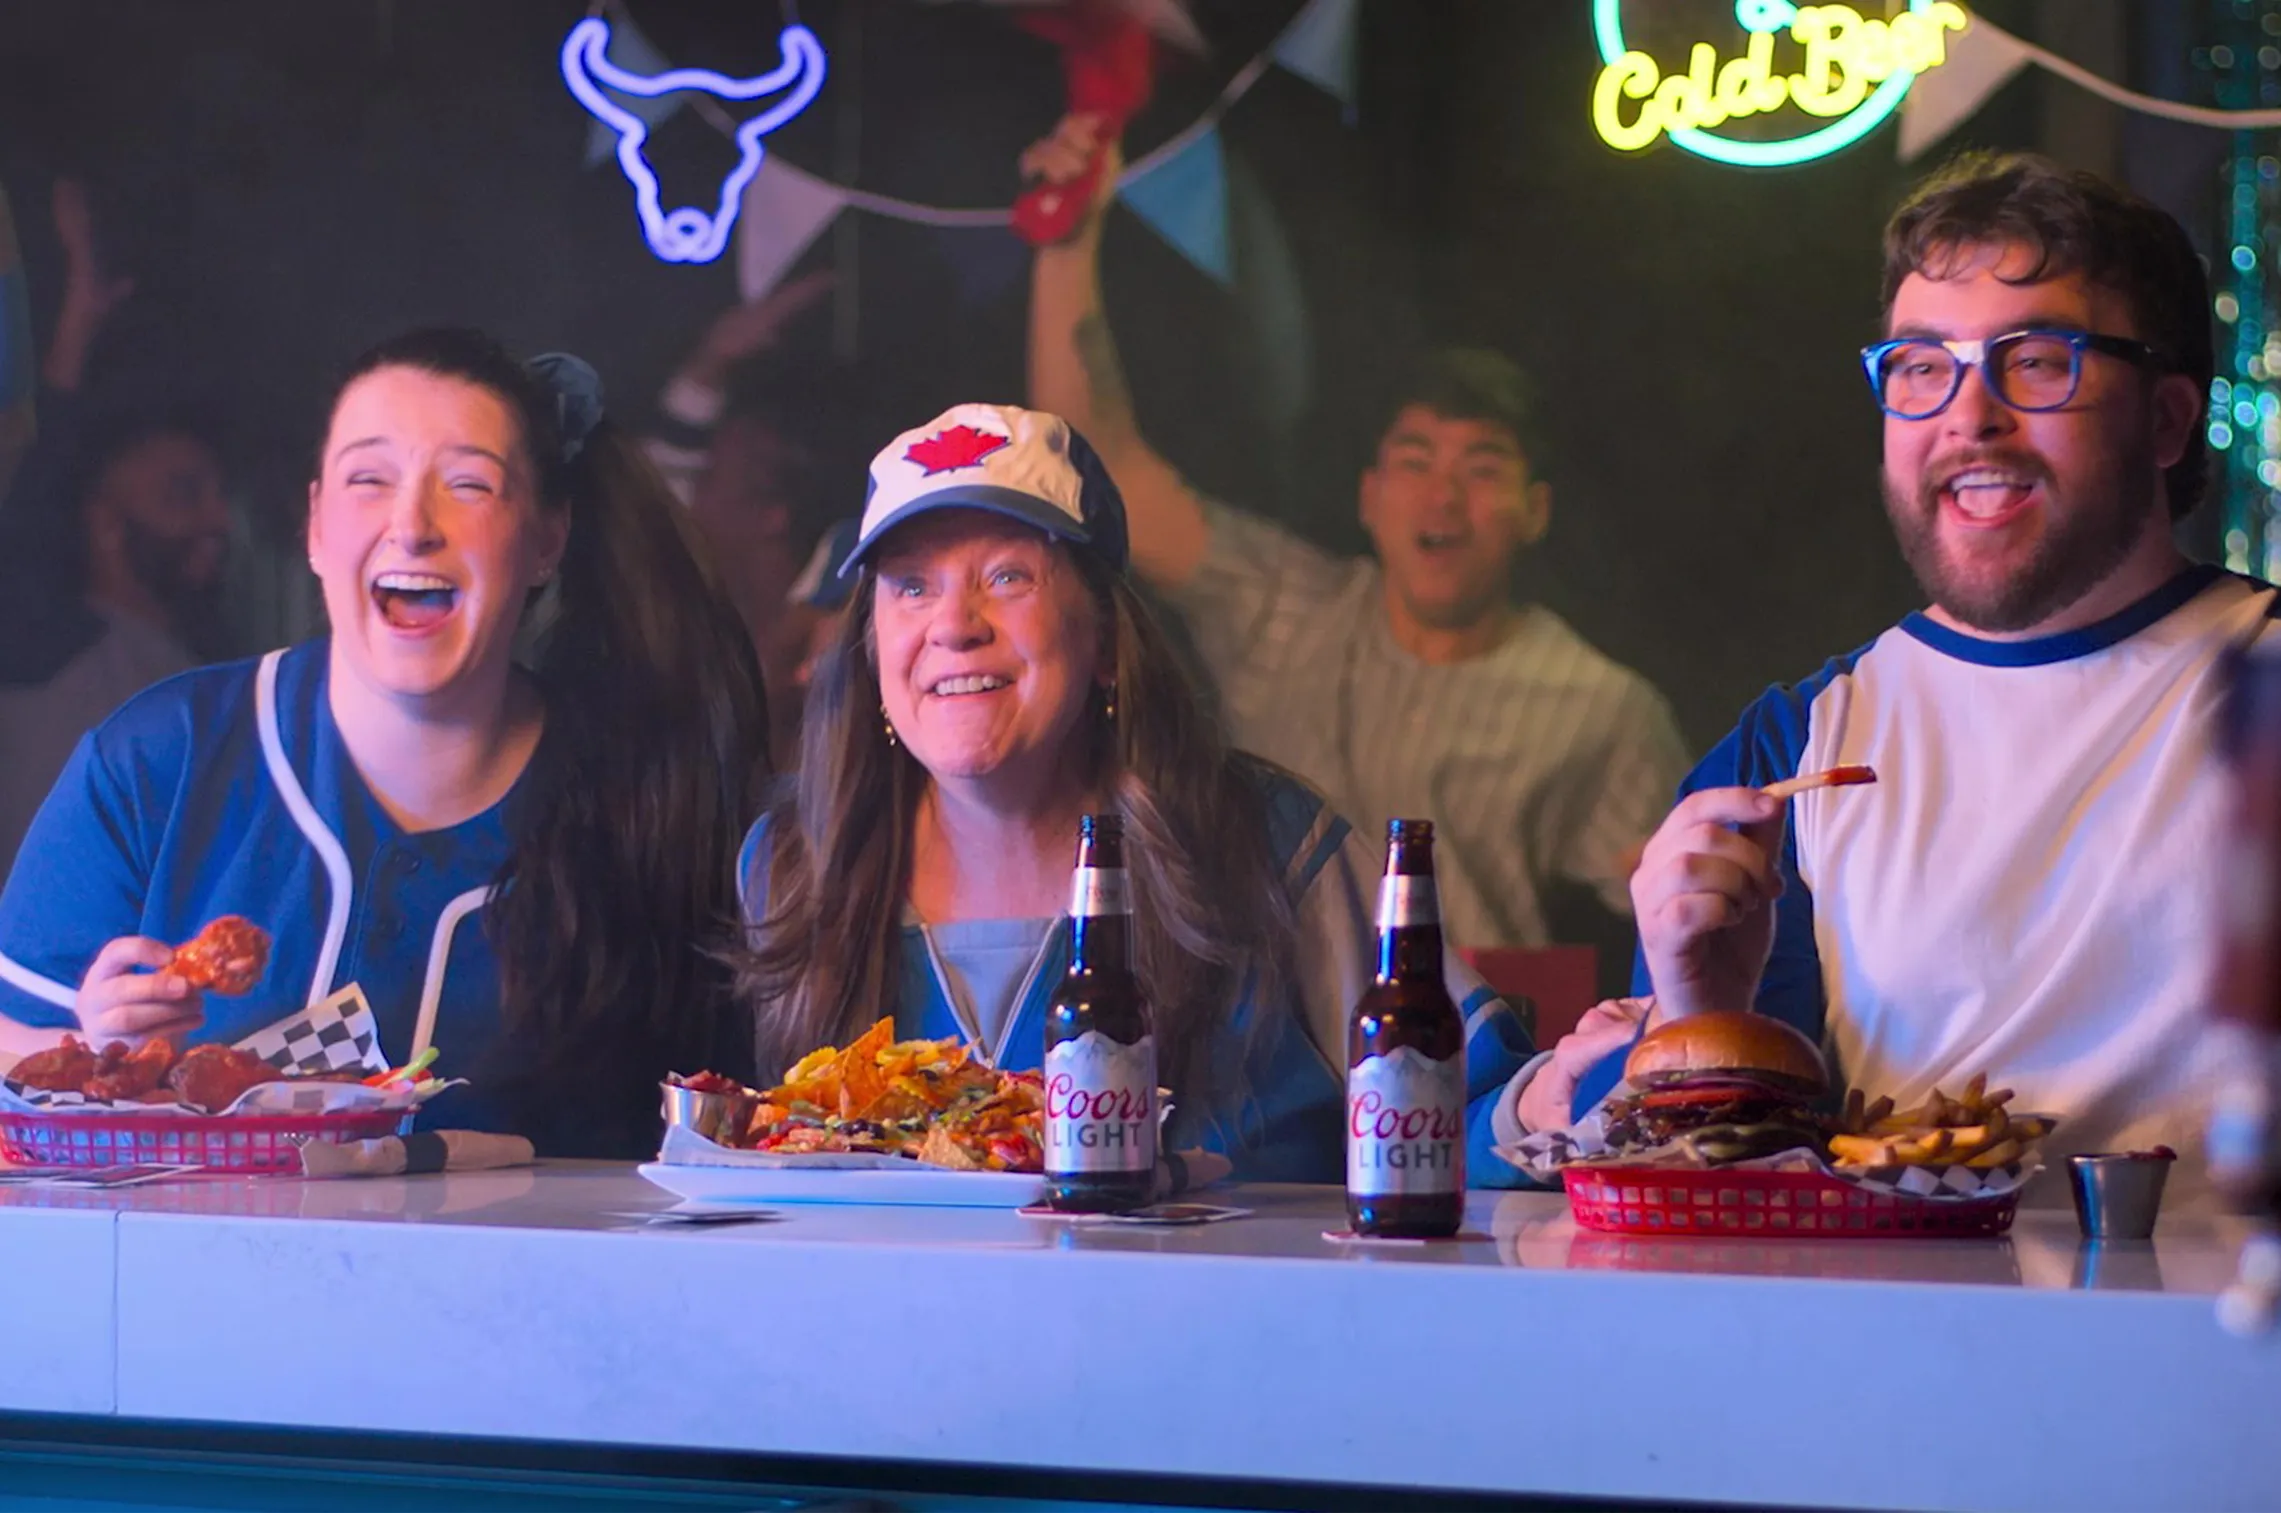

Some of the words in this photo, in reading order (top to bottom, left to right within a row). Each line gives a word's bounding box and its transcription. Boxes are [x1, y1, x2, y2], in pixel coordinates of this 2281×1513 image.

[1593, 31, 1788, 151] Cold
[1786, 2, 1967, 117] Beer
[1047, 1073, 1150, 1120] Coors
[1351, 1090, 1460, 1140] Coors
[1053, 1122, 1142, 1148] LIGHT
[1359, 1143, 1453, 1169] LIGHT
